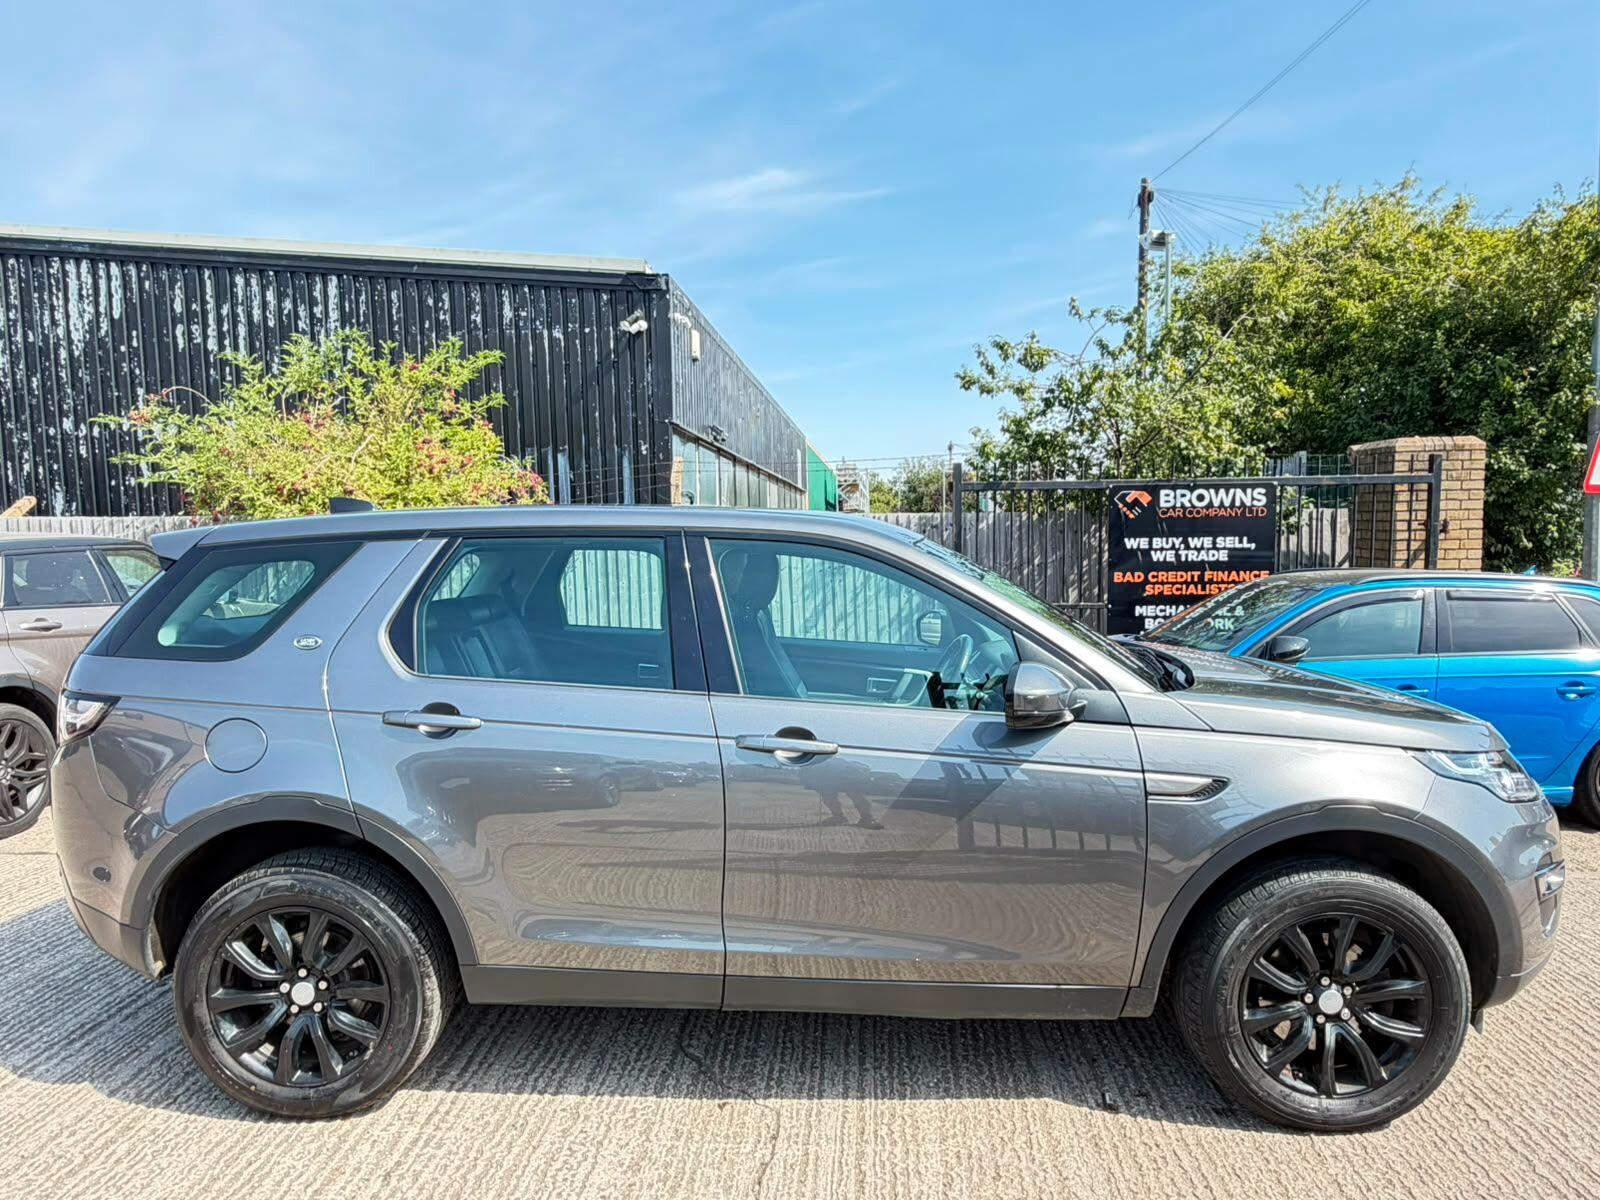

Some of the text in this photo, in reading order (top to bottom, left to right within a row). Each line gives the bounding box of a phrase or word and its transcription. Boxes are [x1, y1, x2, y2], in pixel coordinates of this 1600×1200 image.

[1160, 488, 1267, 507] BROWNS
[1159, 507, 1267, 518] CAR COMPANY LTD
[1124, 536, 1256, 550] WE BUY, WE SELL,
[1151, 550, 1229, 562] WE TRADE
[1113, 570, 1270, 583] BAD CREDIT FINANCE
